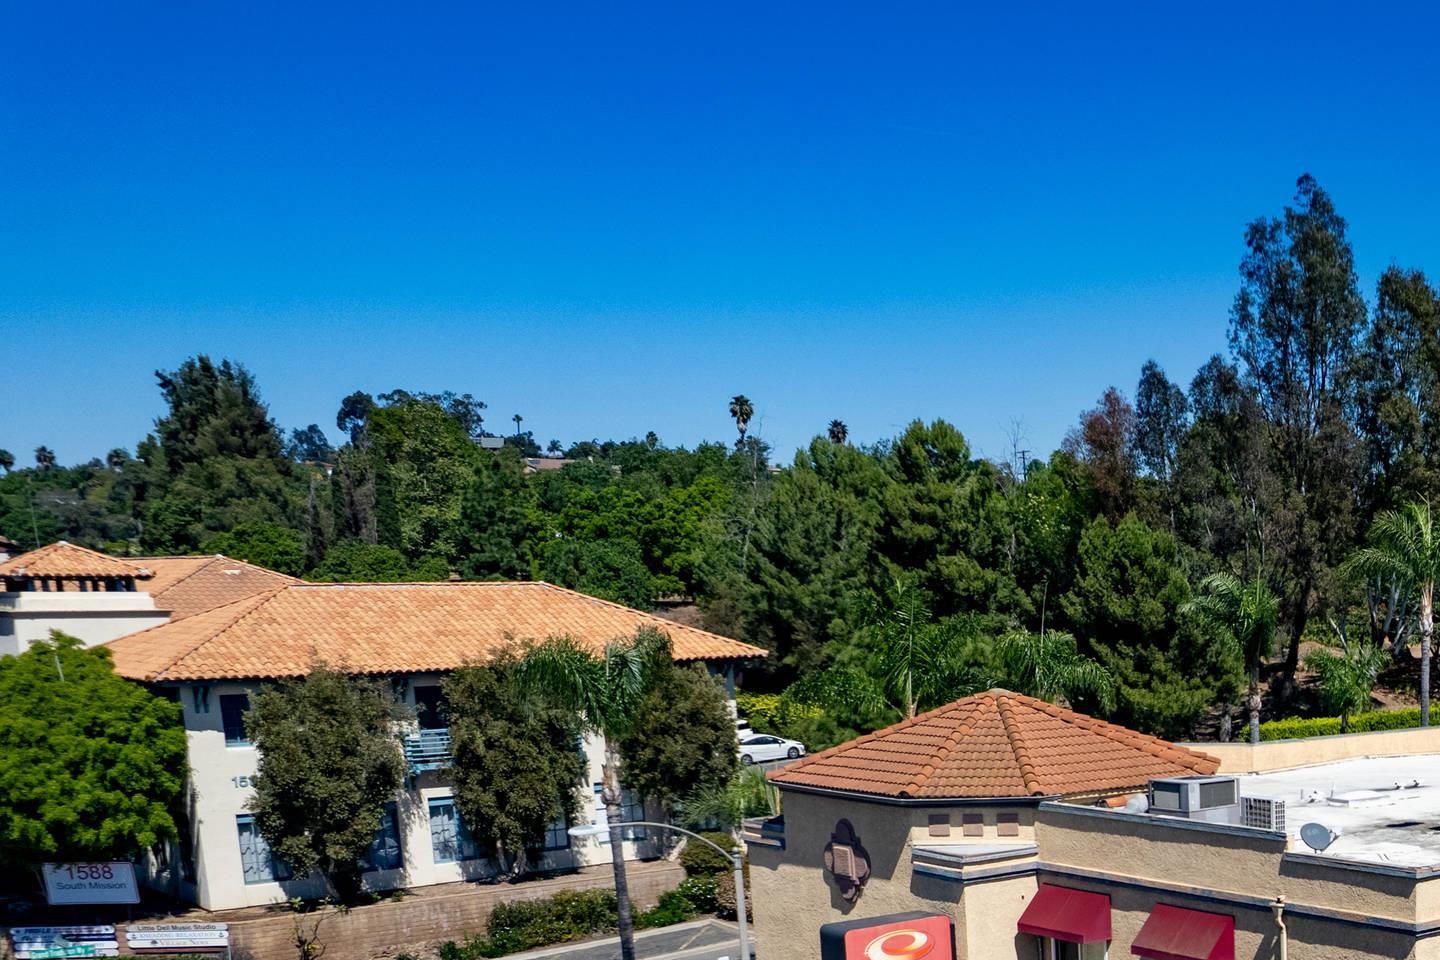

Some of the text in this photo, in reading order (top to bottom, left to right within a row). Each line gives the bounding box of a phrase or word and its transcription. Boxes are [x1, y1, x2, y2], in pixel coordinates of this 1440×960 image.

[65, 865, 114, 880] 1588
[56, 882, 126, 890] South Mission
